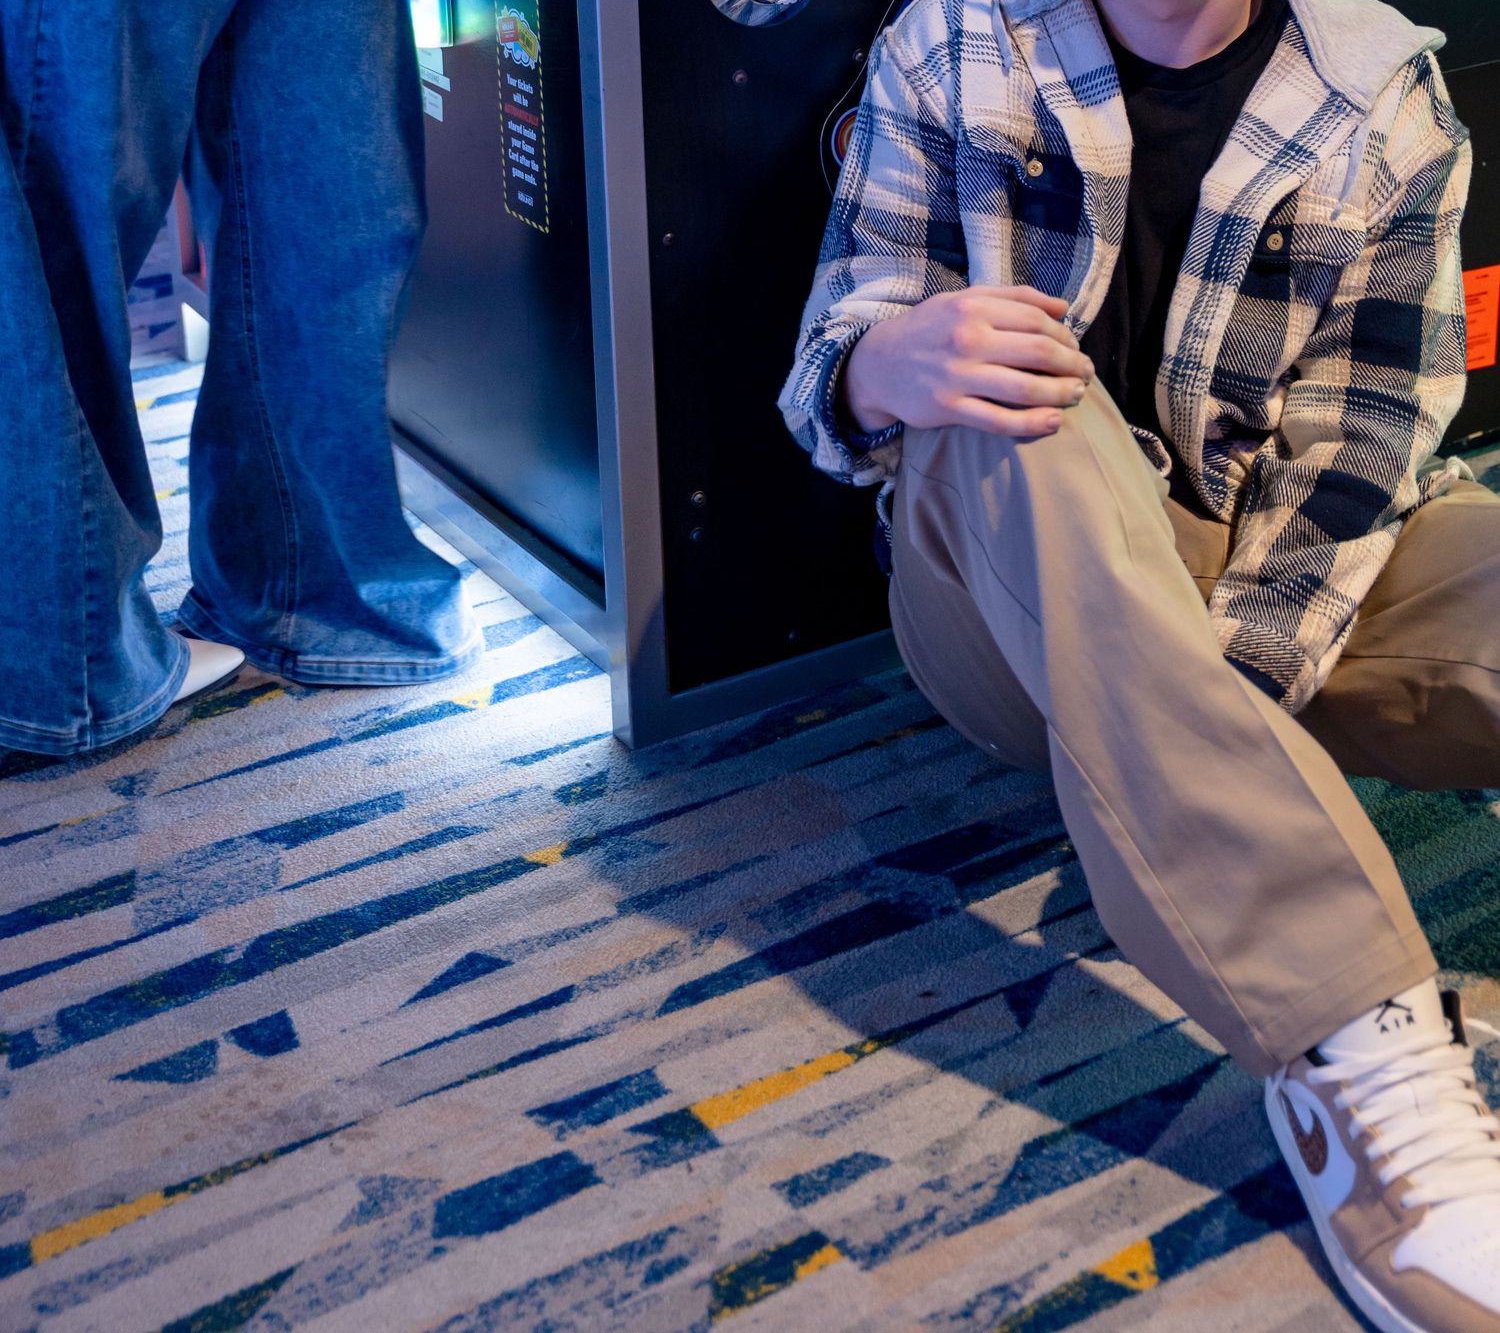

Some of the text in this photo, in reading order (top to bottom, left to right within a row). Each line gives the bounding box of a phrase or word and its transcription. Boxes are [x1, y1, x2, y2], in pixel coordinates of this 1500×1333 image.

[506, 73, 534, 94] Your tickets
[512, 92, 529, 107] will be
[508, 120, 537, 141] stored inside
[511, 137, 535, 155] your Game
[508, 148, 539, 172] Card after the
[511, 167, 525, 180] game
